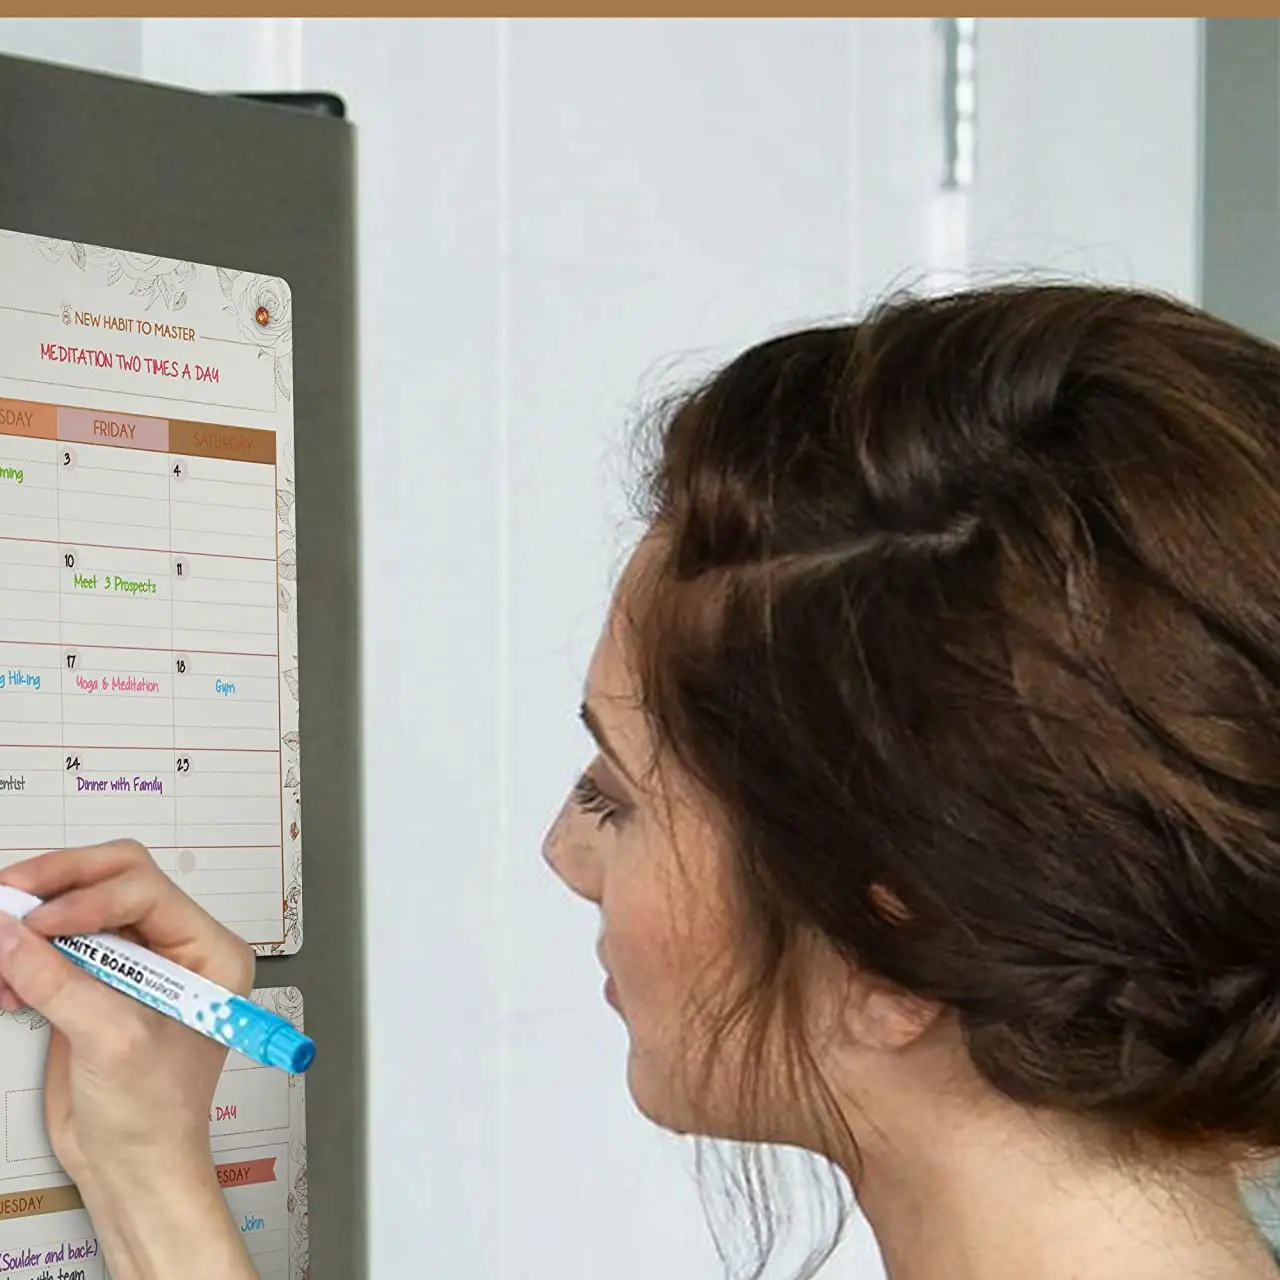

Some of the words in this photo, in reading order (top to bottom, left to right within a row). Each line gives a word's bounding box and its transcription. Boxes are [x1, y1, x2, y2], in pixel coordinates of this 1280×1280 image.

[75, 311, 101, 327] NEW
[104, 316, 133, 332] HABIT
[136, 320, 152, 335] TO
[155, 323, 195, 341] MASTER
[41, 343, 112, 368] MEDITATION
[116, 354, 141, 372] TWO
[144, 359, 178, 377] TIMES
[182, 364, 191, 379] A
[195, 365, 218, 383] DAY
[94, 420, 135, 439] FRIDAY
[193, 432, 253, 453] SATURDAY
[74, 574, 97, 589] Meet
[105, 576, 111, 589] 3
[115, 576, 156, 595] Prospects
[76, 777, 108, 791] Dinner
[111, 777, 130, 791] with
[134, 777, 162, 794] Family
[101, 953, 143, 984] BOARD
[216, 1105, 236, 1121] DAY
[45, 1243, 64, 1264] and
[68, 1238, 98, 1260] back)
